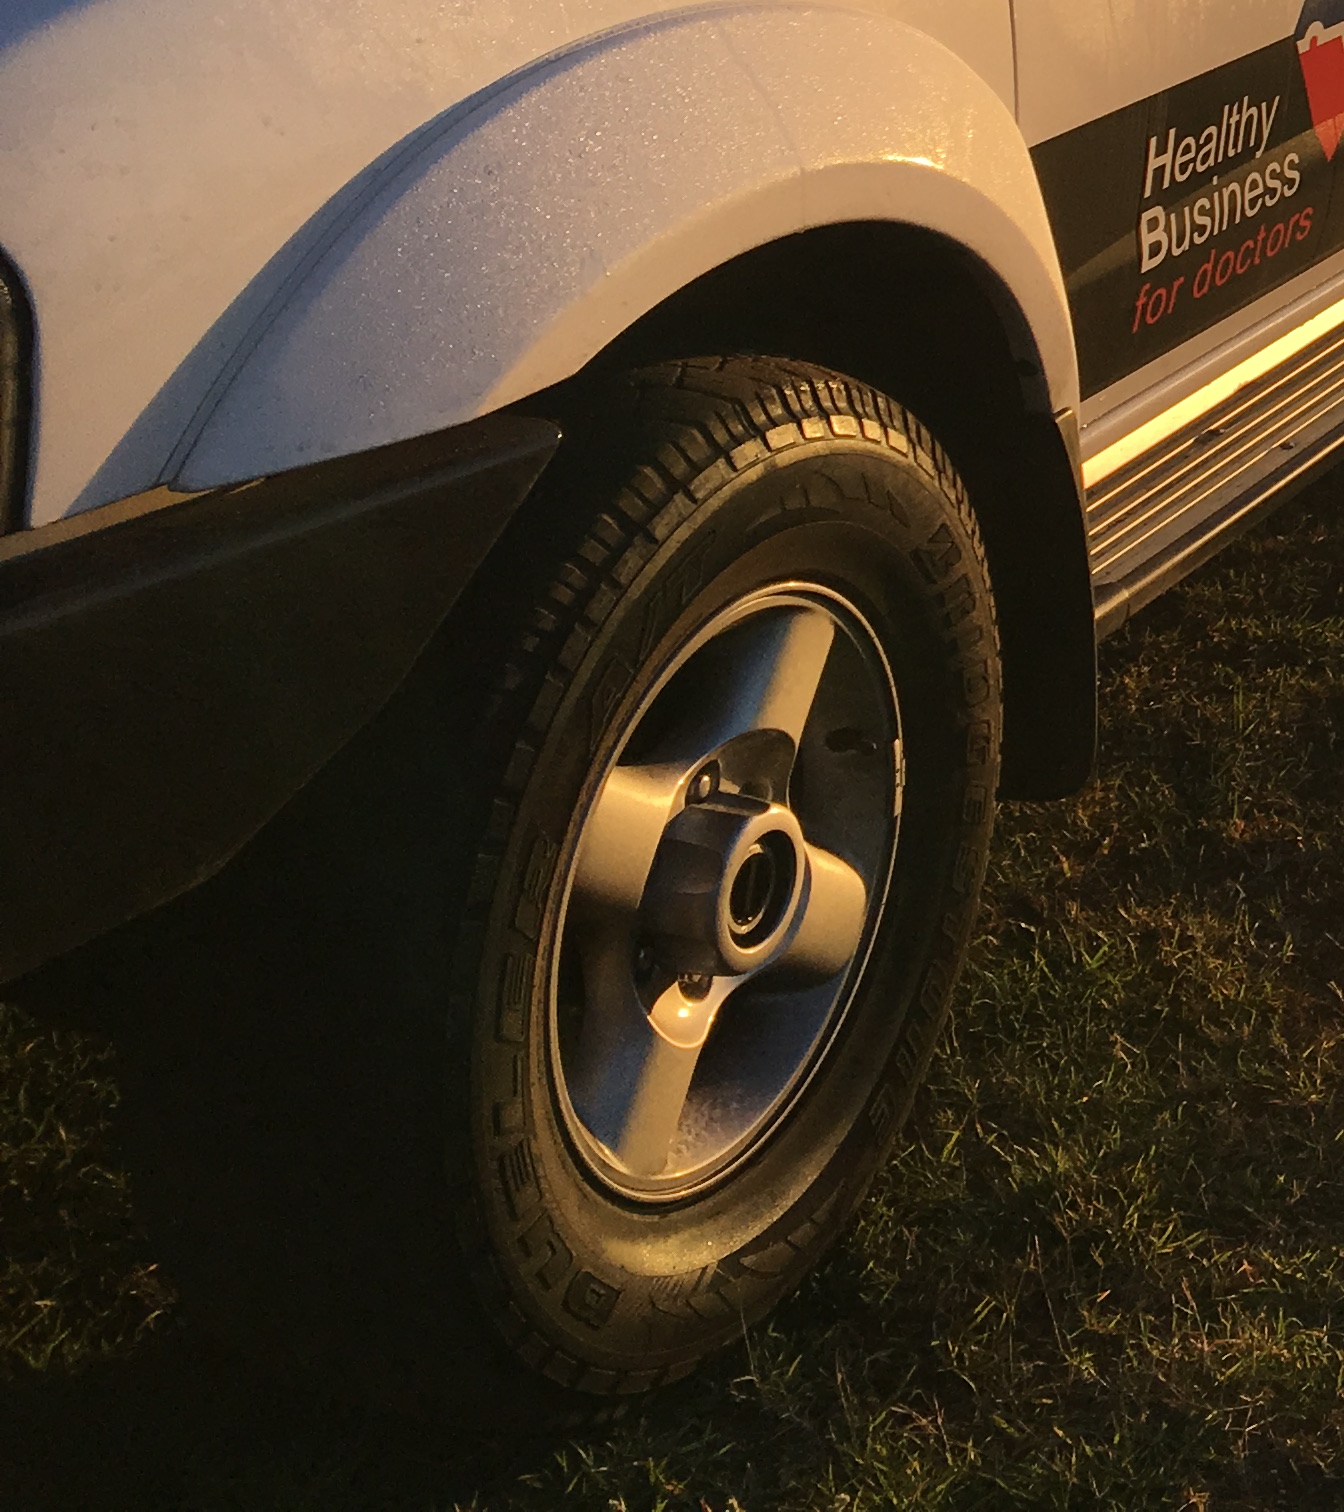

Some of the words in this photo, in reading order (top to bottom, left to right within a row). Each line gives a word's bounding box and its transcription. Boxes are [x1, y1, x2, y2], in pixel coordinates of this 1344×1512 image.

[1143, 95, 1281, 199] Healthy
[1131, 282, 1186, 334] for
[1192, 205, 1315, 299] doctors
[1140, 151, 1301, 274] Business
[492, 833, 623, 1331] DUELER
